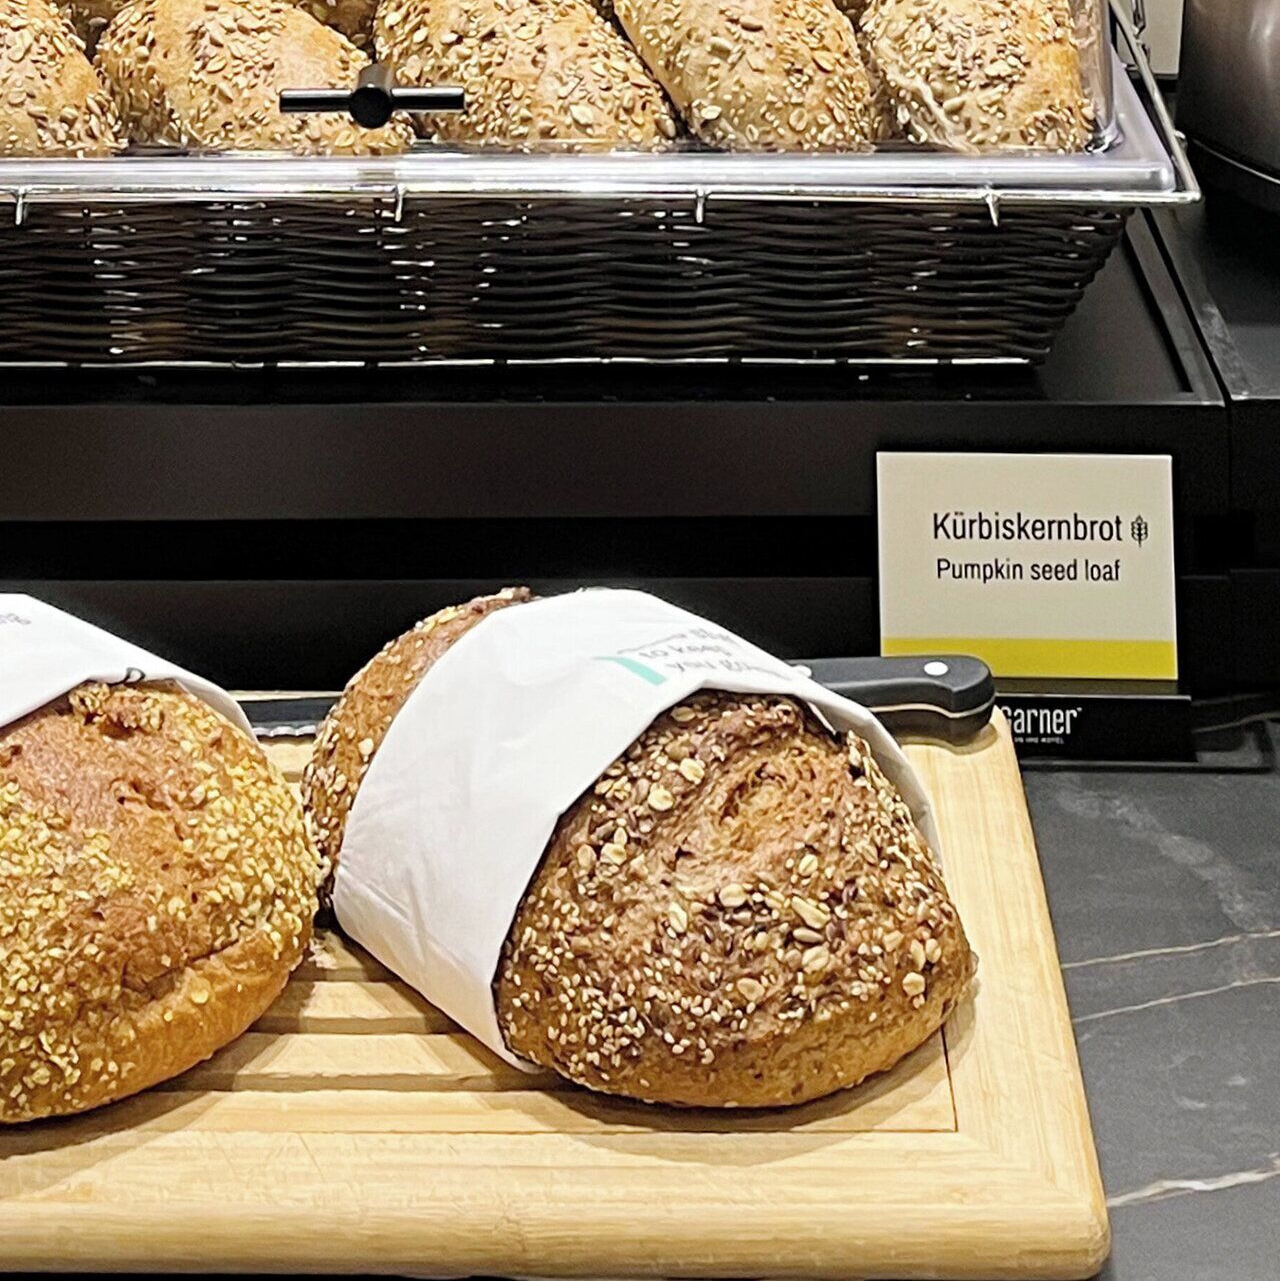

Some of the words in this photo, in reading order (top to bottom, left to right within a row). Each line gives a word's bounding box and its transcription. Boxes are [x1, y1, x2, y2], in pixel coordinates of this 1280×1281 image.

[932, 512, 1123, 542] Kürbiskernbrot
[936, 558, 1024, 584] Pumpkin
[1030, 560, 1079, 581] seed
[1084, 559, 1121, 582] loaf
